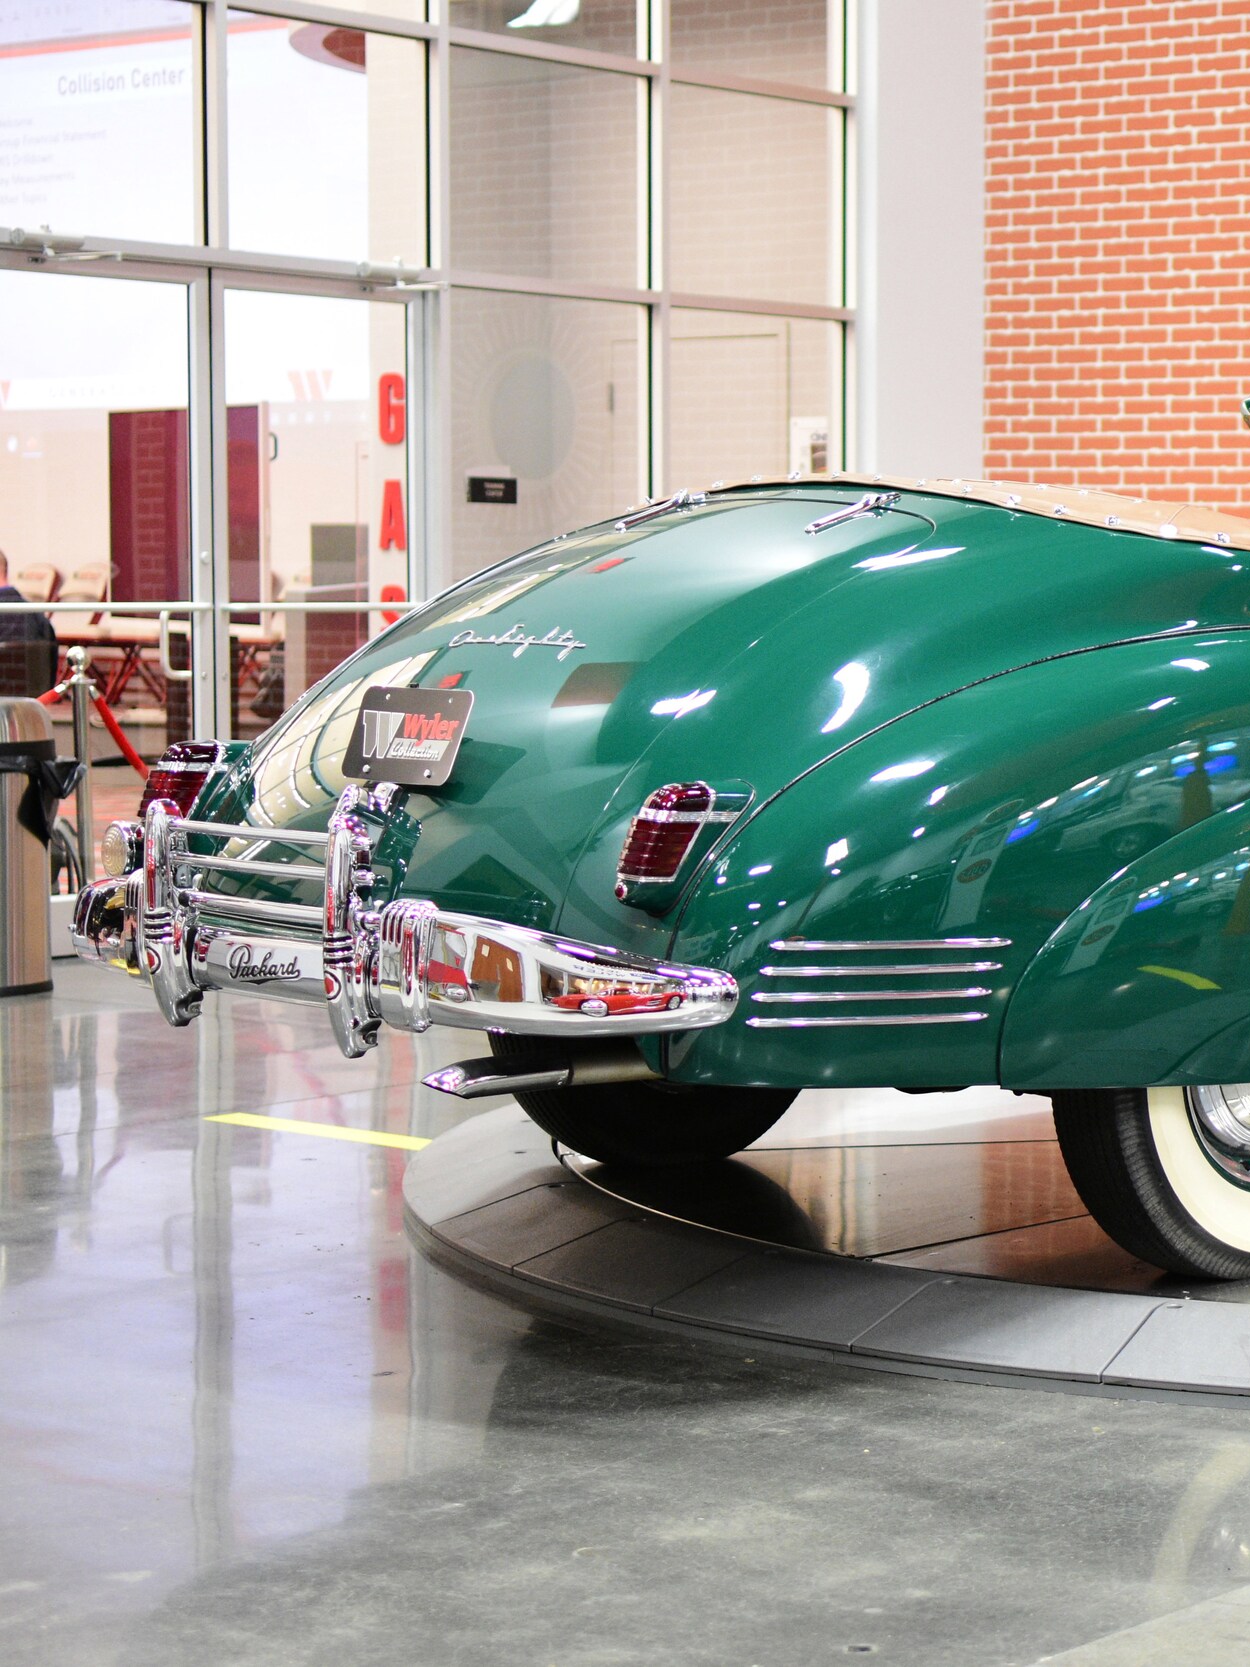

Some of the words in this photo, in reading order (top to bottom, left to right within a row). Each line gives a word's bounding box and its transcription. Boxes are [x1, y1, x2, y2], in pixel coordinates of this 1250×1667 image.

[57, 70, 126, 96] Collision
[130, 66, 186, 90] Center
[403, 712, 460, 747] Wyler
[390, 740, 441, 760] Collection
[229, 944, 301, 984] Packard
